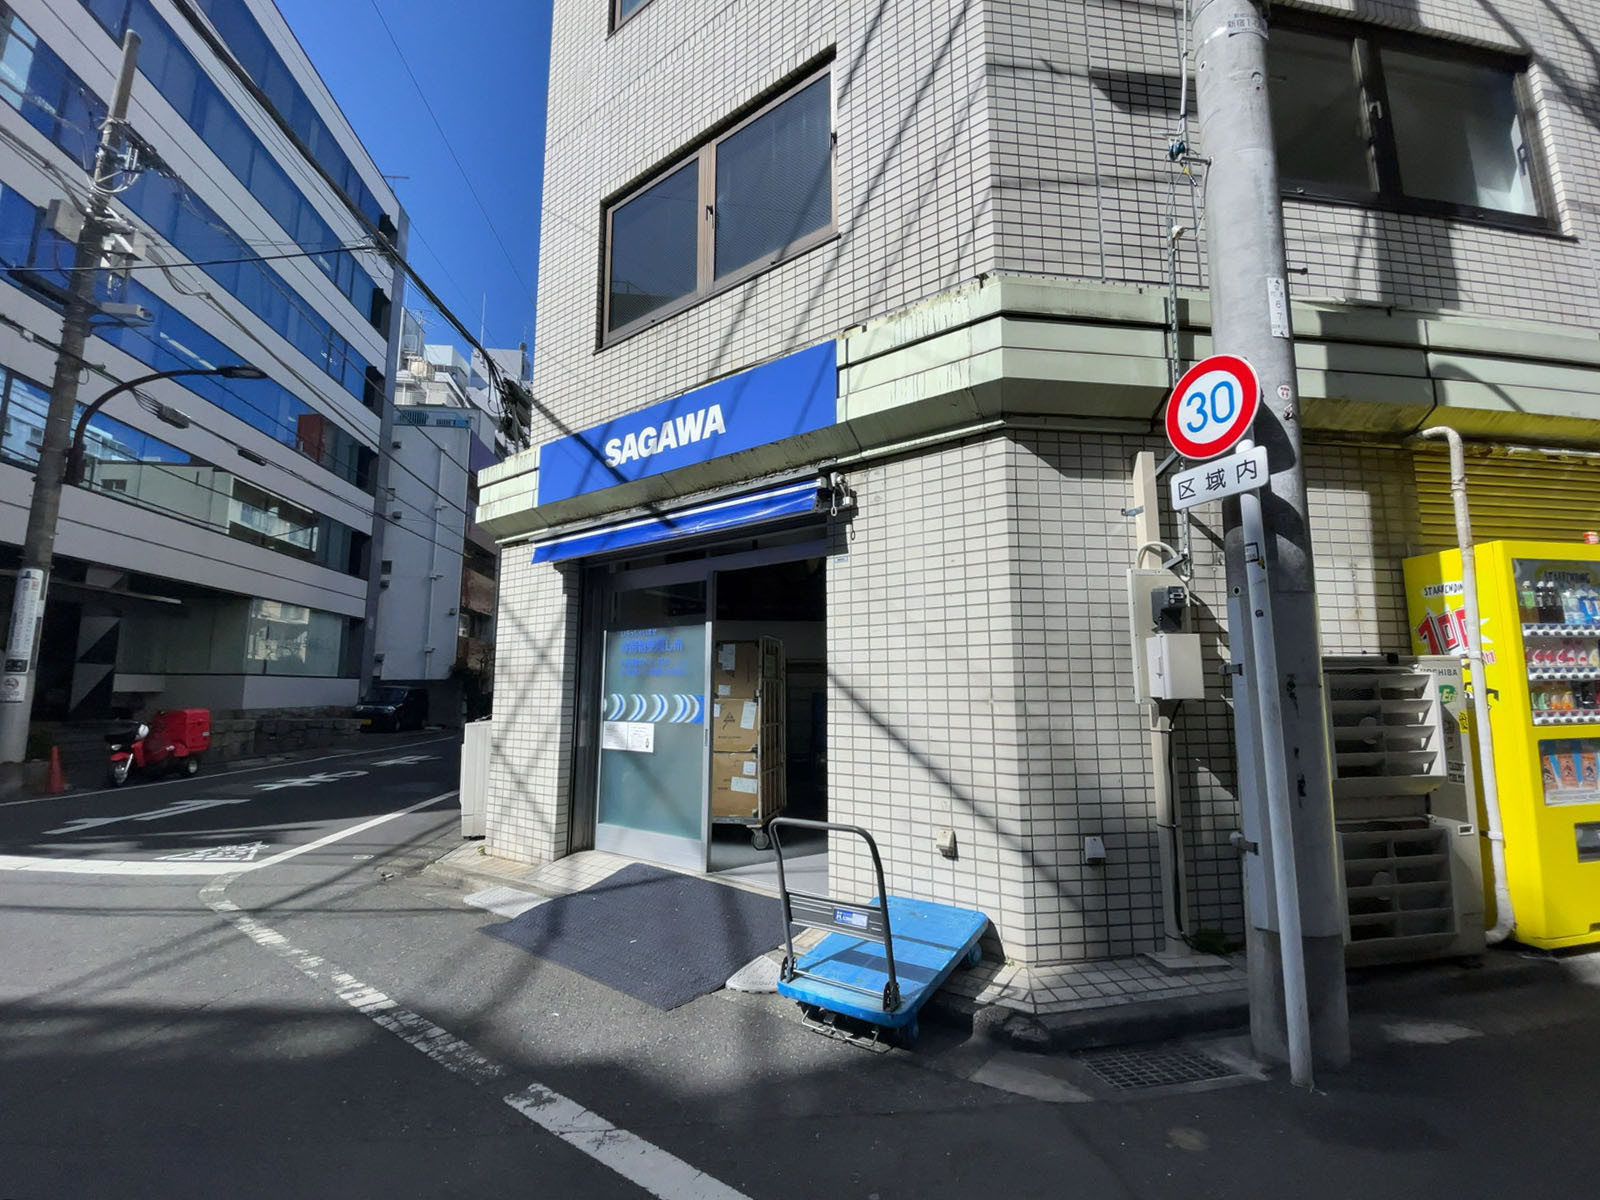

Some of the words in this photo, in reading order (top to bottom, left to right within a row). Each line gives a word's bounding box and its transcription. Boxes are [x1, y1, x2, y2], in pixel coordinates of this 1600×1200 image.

[1186, 380, 1235, 433] 30
[604, 404, 726, 468] SAGAWA
[1178, 459, 1258, 501] 区域内
